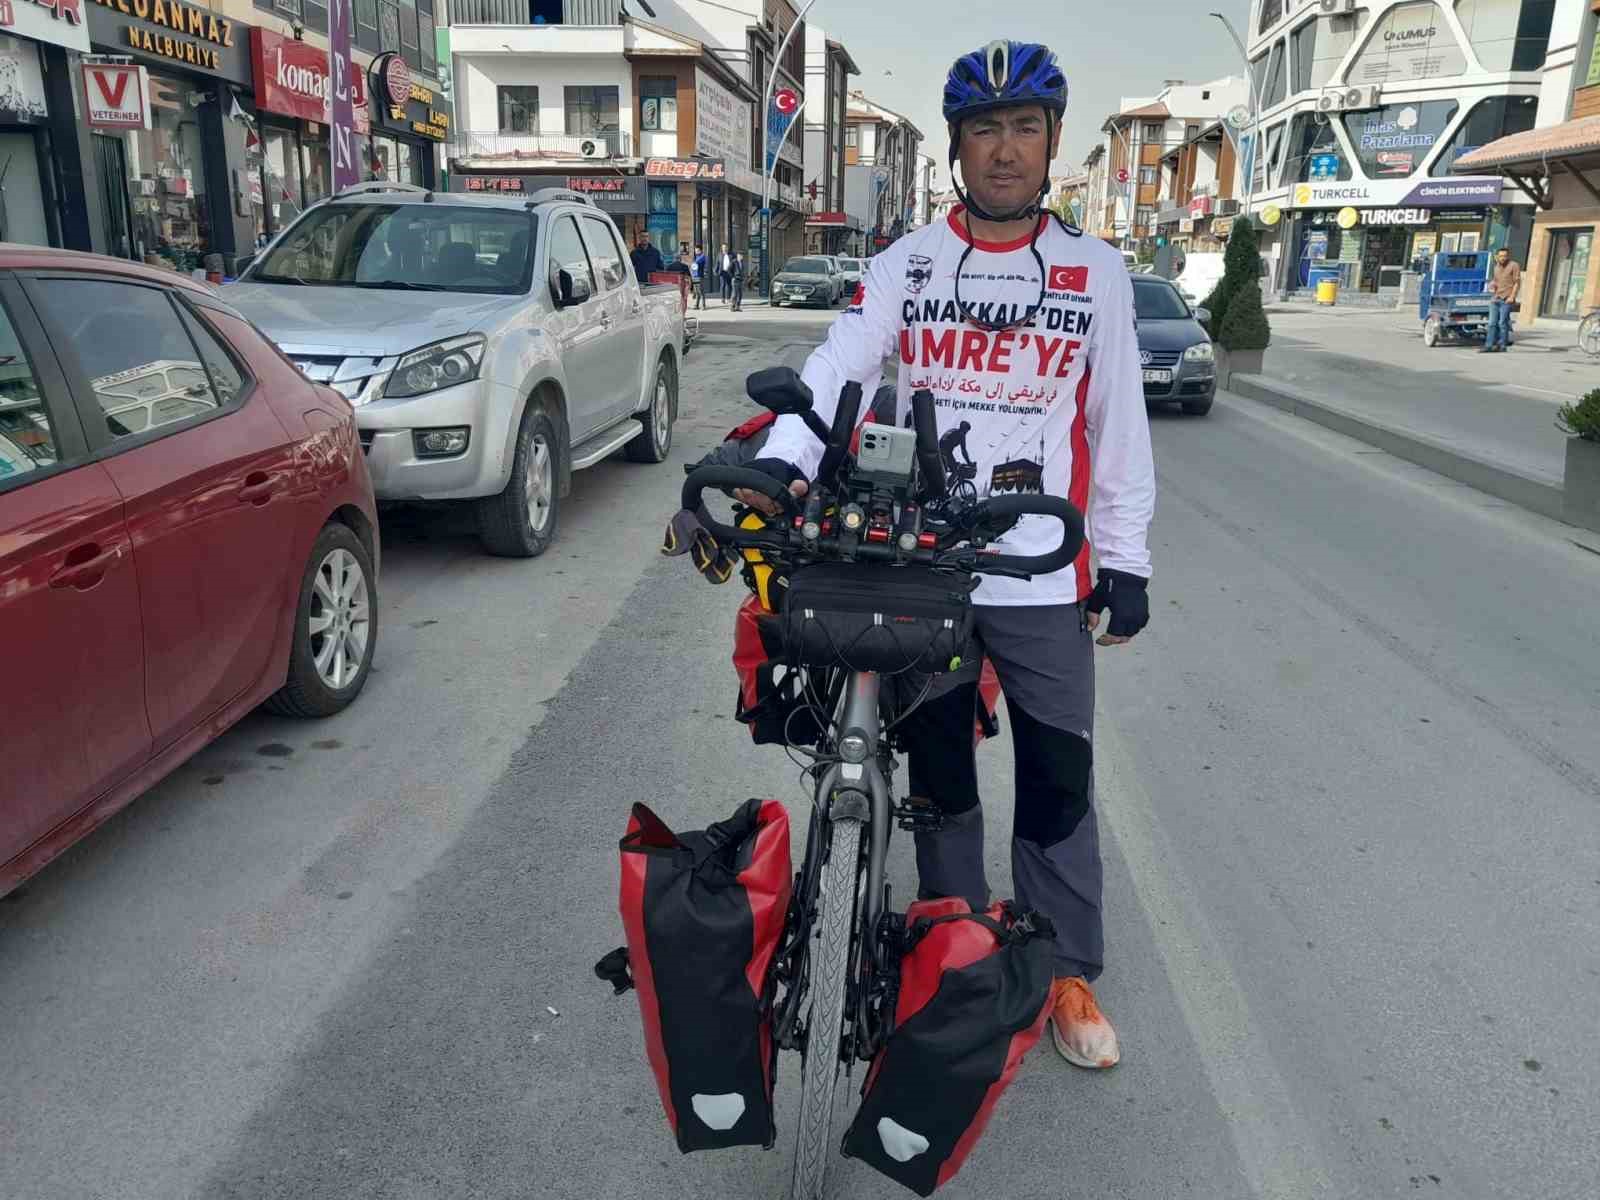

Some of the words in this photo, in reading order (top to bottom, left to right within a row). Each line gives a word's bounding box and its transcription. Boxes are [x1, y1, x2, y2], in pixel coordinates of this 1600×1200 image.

[128, 25, 220, 69] NALBURİYE
[1361, 132, 1435, 150] Pazarlama
[1313, 188, 1370, 200] TURKCELL
[1360, 209, 1431, 225] TURKCELL
[902, 298, 1093, 337] ÇANAKKALE'DEN
[899, 328, 1082, 378] UMRE'YE
[958, 378, 982, 394] مكة
[967, 400, 996, 413] MEKKE
